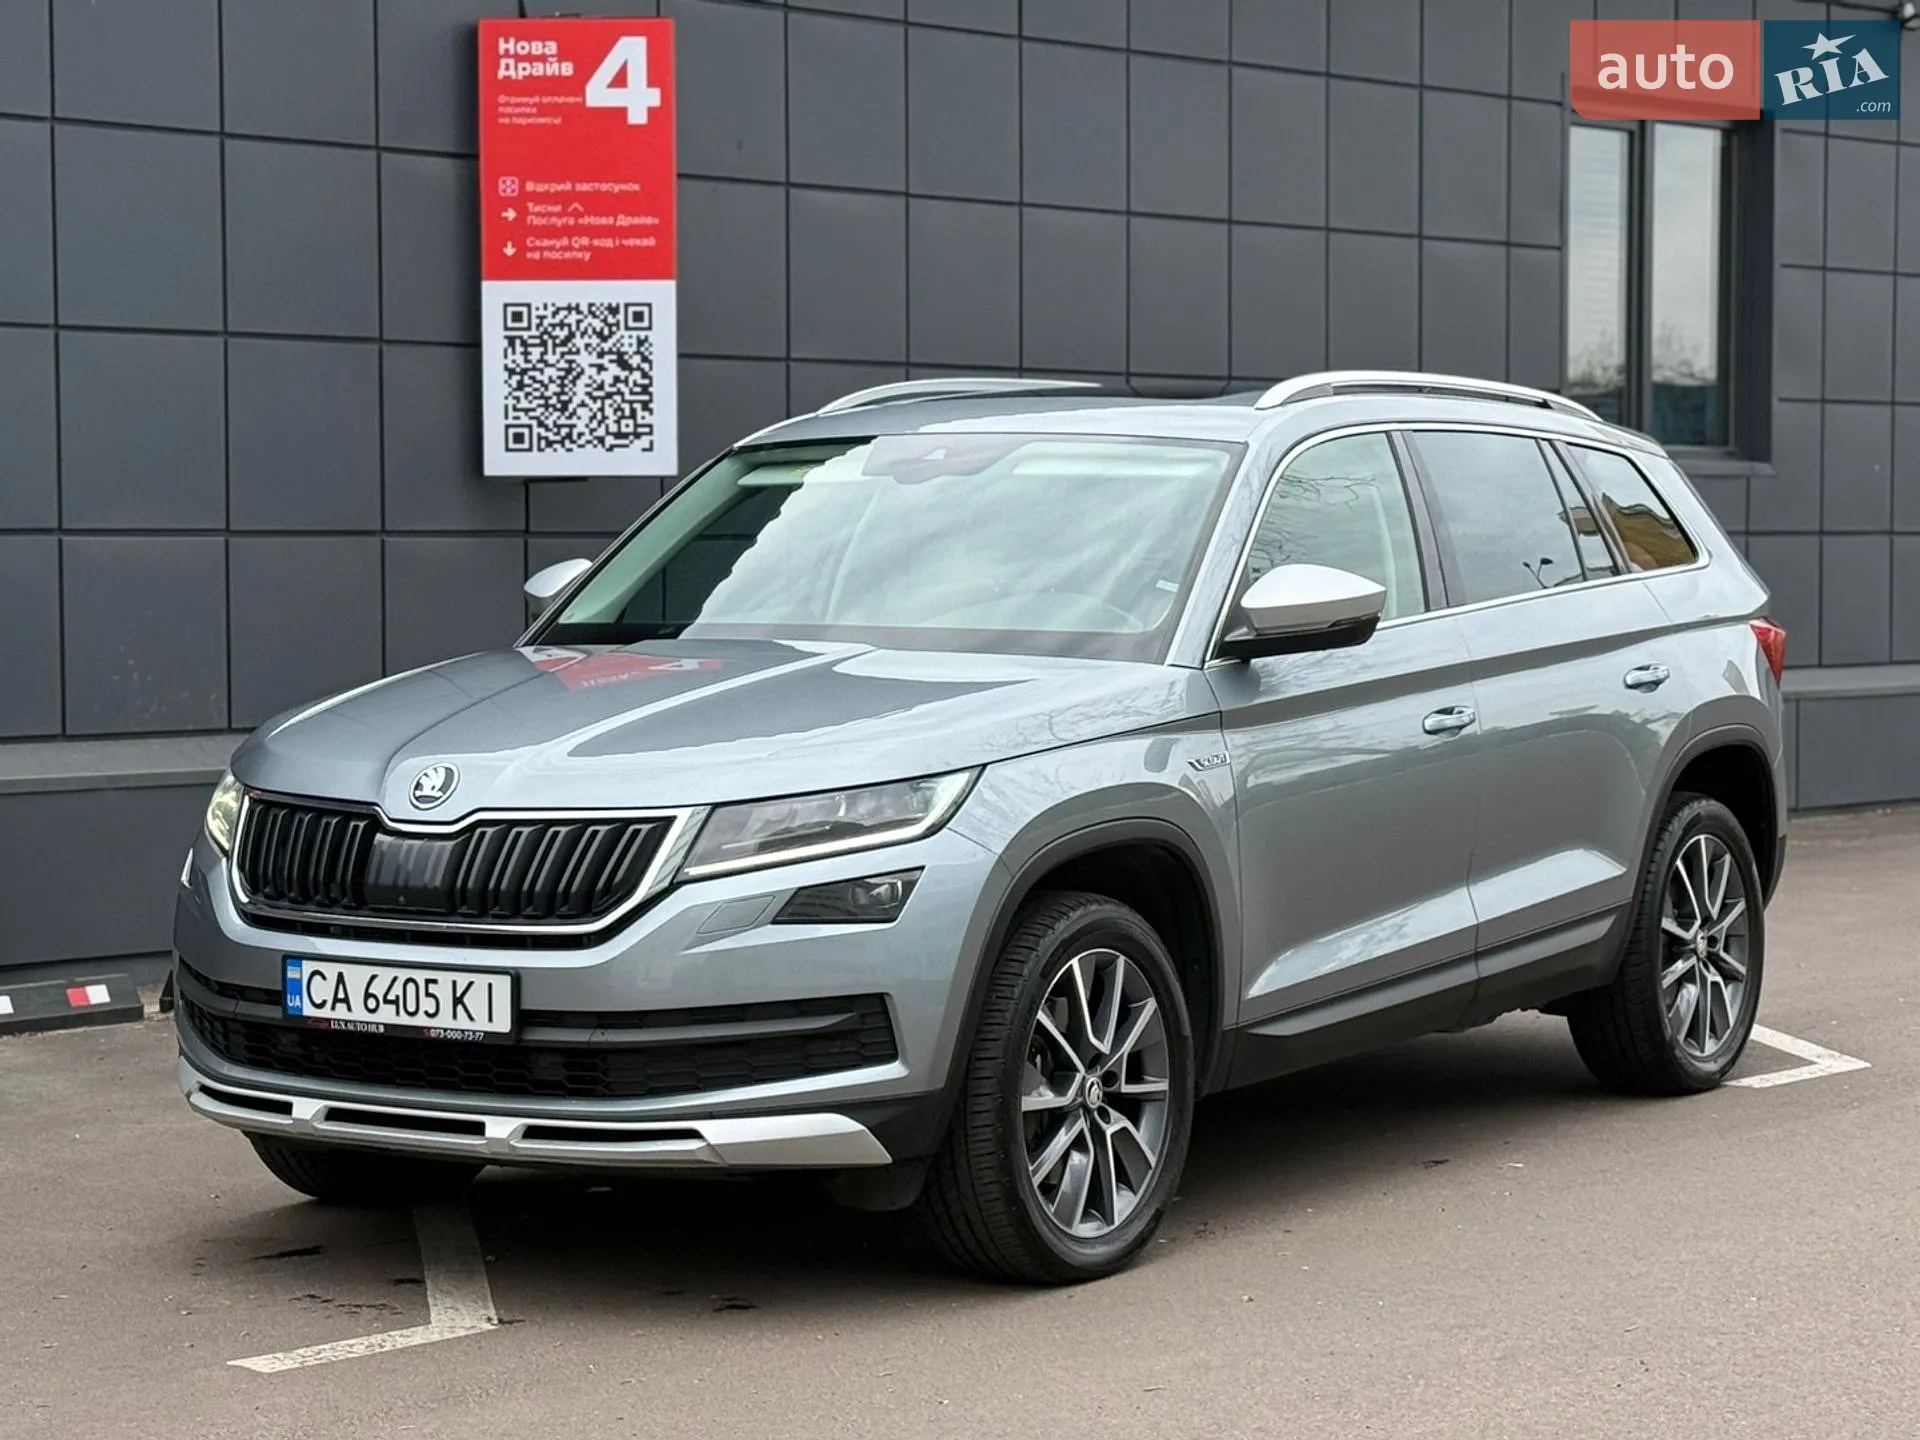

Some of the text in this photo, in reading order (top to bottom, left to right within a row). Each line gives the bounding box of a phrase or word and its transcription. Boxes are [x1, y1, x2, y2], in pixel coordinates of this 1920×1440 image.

[498, 37, 558, 56] Нова
[497, 56, 574, 80] Драйв
[585, 35, 662, 125] 4
[525, 181, 641, 193] Відкрий застосунок
[526, 214, 660, 227] Послуга «Нова Драйв»
[526, 236, 569, 248] Скануй
[571, 236, 614, 248] QR-код
[622, 236, 656, 247] чекай
[526, 251, 592, 262] на посилку
[287, 994, 302, 1008] UA
[306, 969, 353, 1013] CA
[363, 973, 441, 1019] 6405
